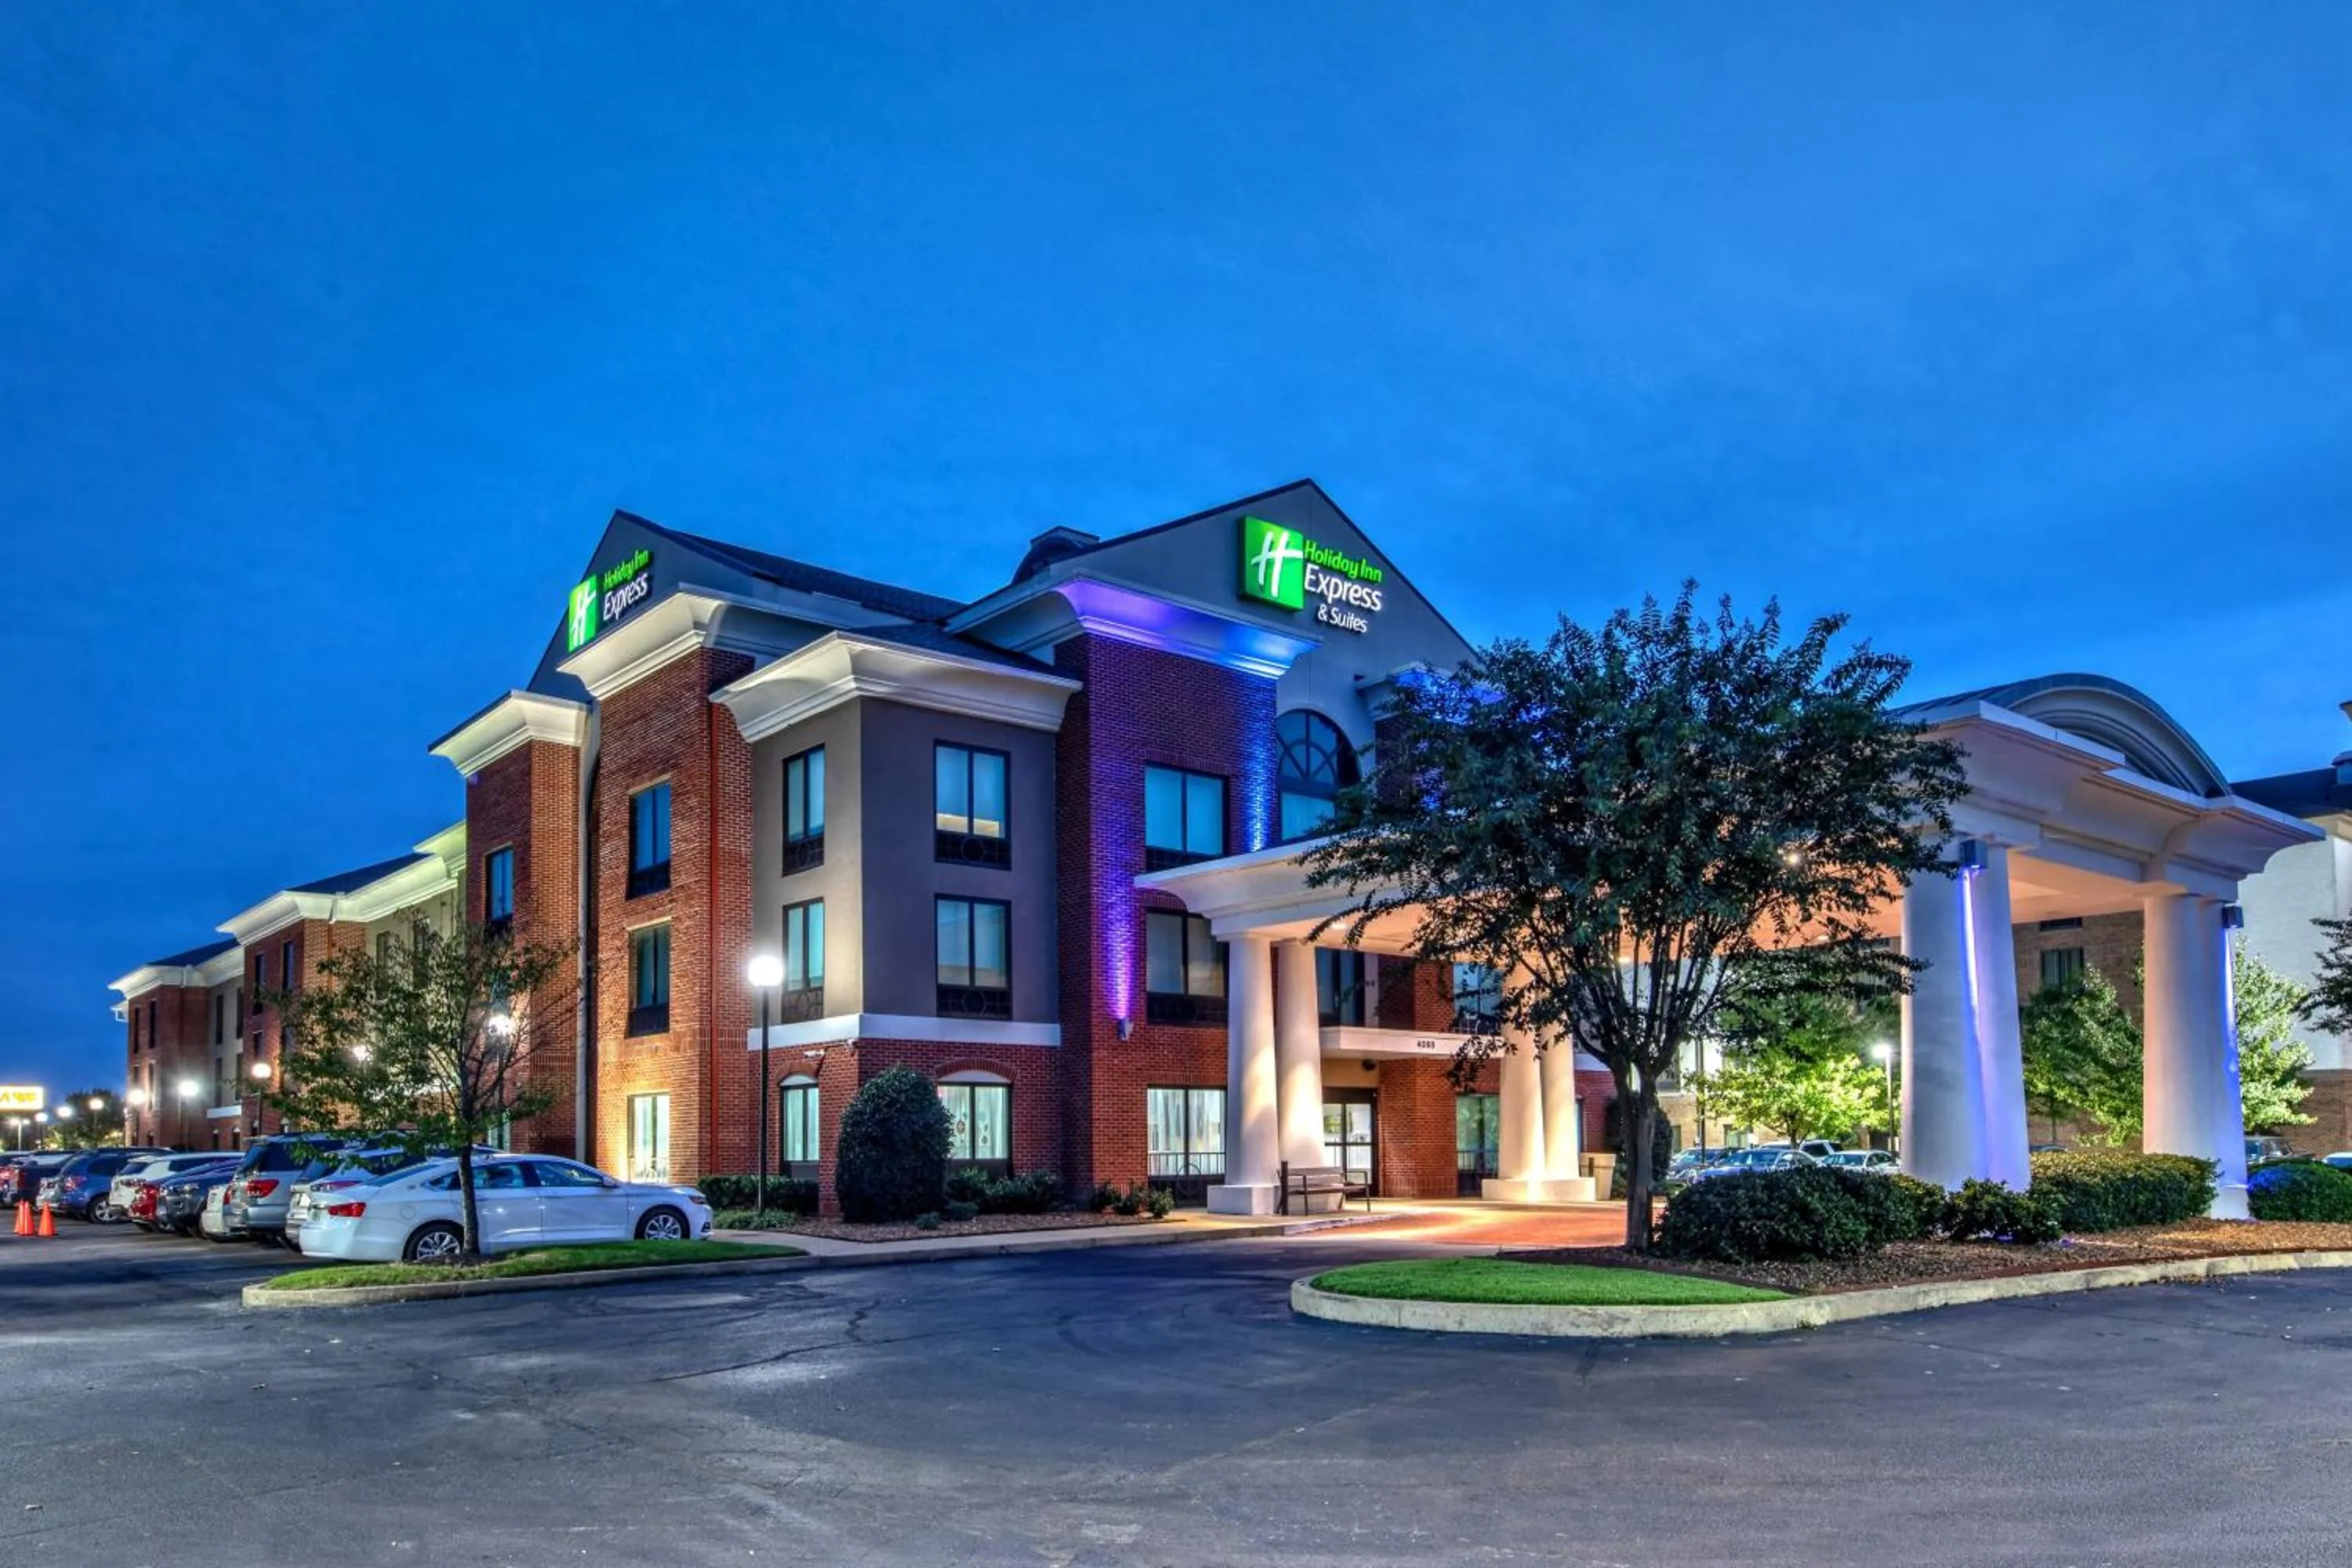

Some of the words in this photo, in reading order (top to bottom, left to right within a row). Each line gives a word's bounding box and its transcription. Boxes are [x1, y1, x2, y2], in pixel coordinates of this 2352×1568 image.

[603, 560, 635, 591] Holiday
[634, 550, 649, 569] Inn
[1305, 539, 1359, 579] Holiday
[1360, 558, 1382, 583] Inn
[603, 572, 648, 621] Express
[1304, 564, 1382, 611] Express
[1317, 604, 1328, 622] &
[1330, 608, 1368, 633] Suites
